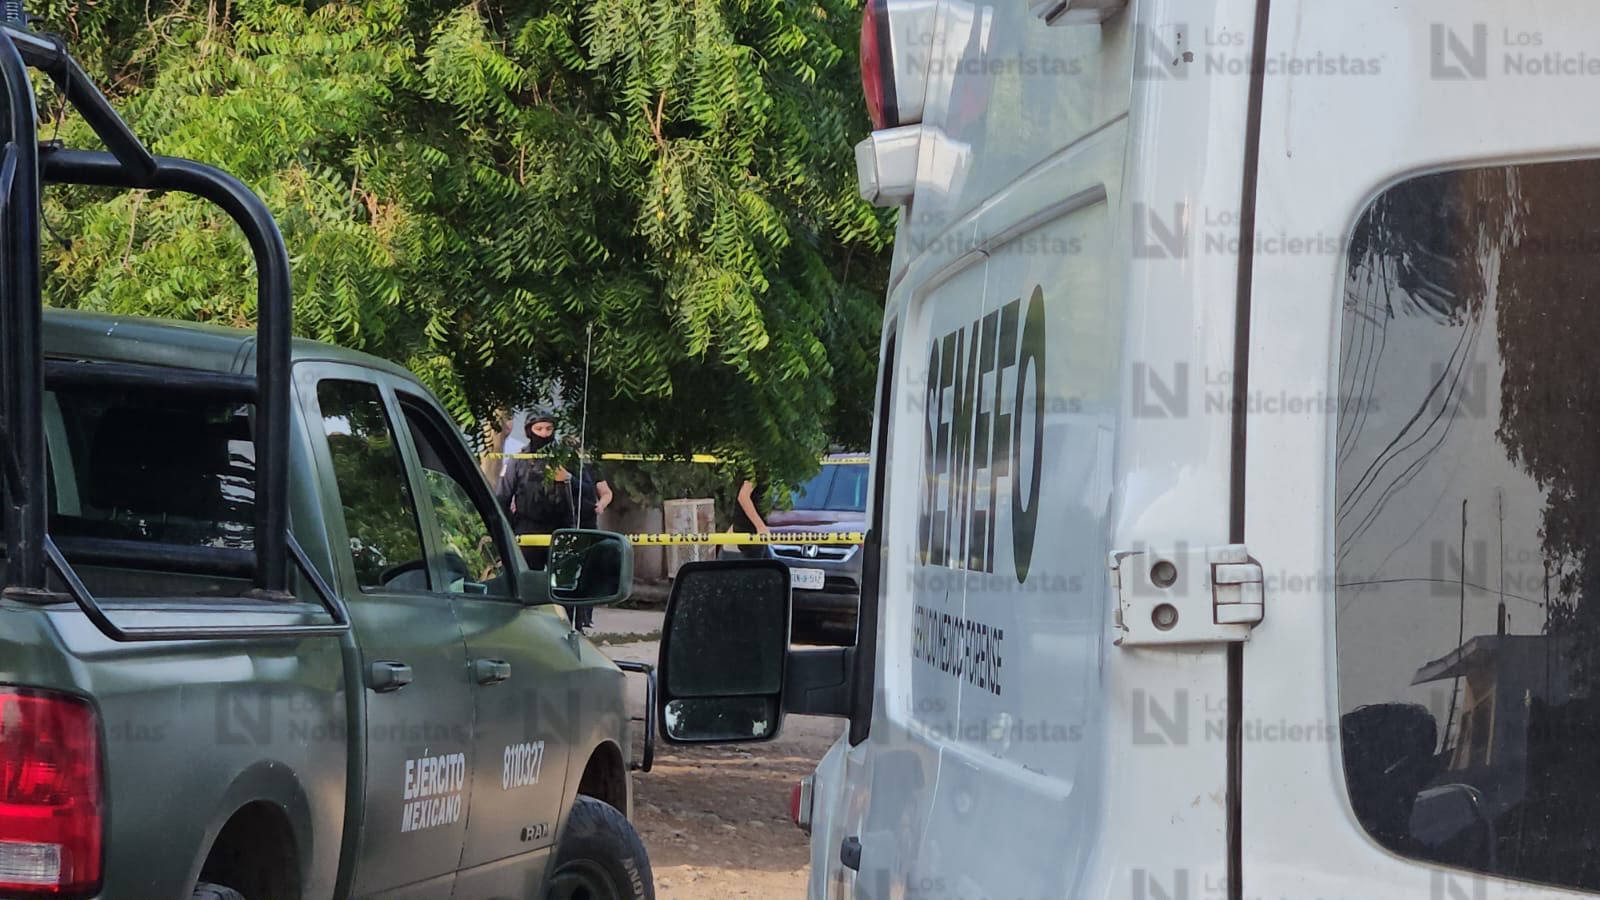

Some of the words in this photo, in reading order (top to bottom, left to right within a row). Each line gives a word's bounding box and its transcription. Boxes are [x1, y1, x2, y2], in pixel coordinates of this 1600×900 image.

[918, 284, 1046, 584] SEMEFO
[404, 748, 465, 800] EJÉRCITO
[503, 740, 545, 790] 8110327
[401, 794, 461, 833] MEXICANO
